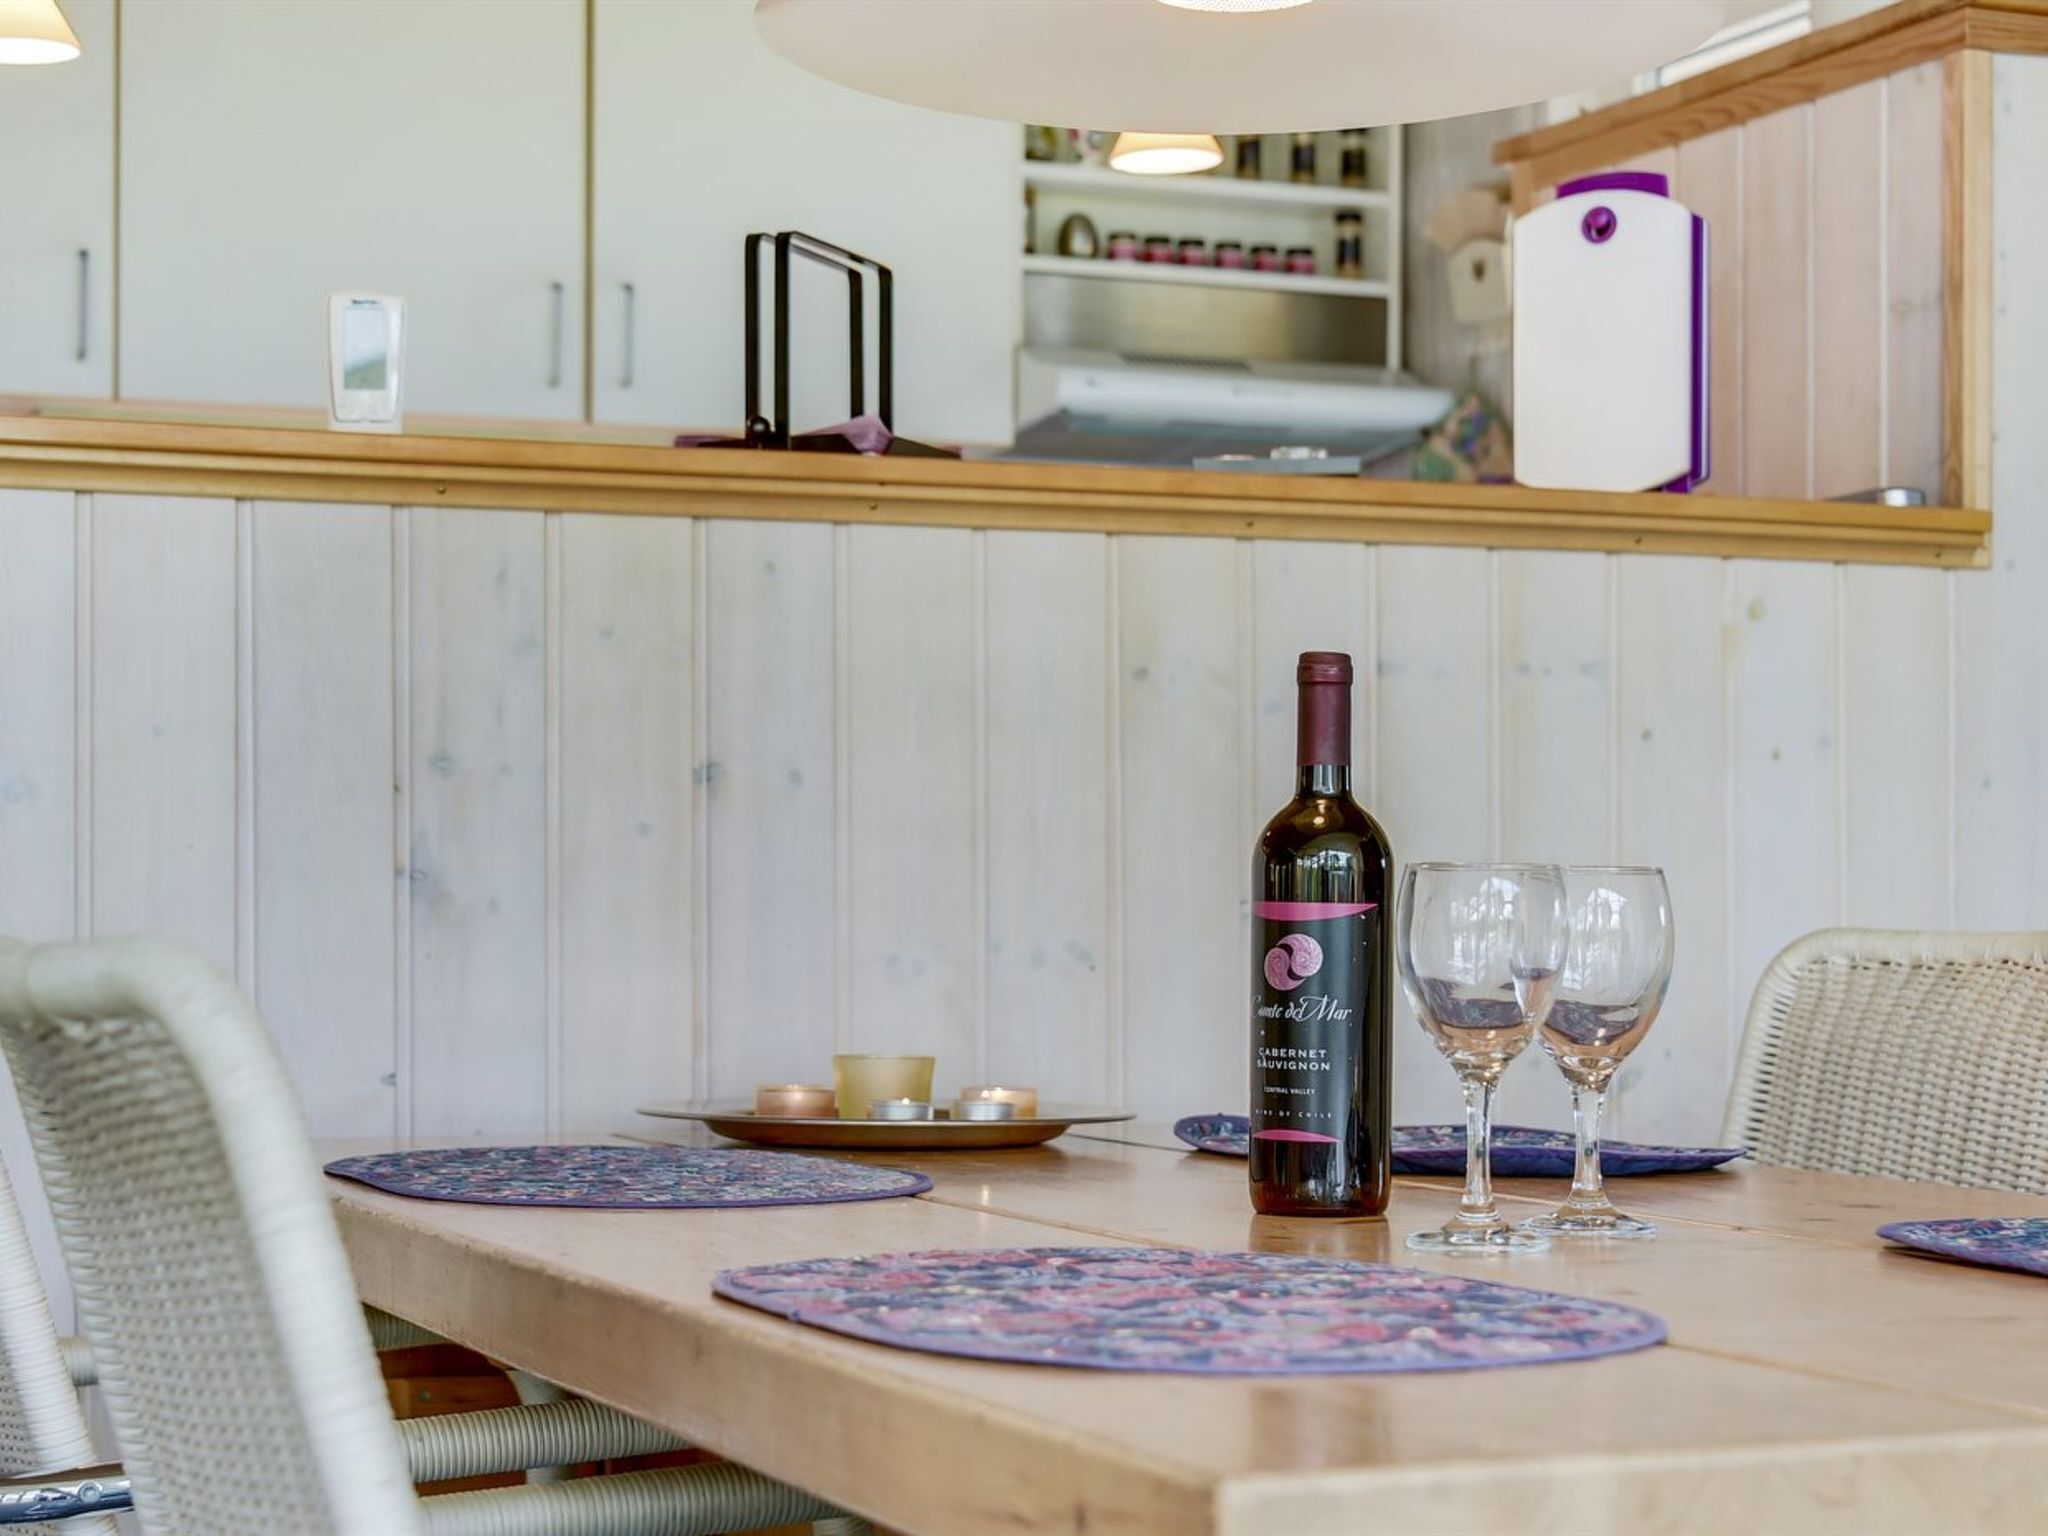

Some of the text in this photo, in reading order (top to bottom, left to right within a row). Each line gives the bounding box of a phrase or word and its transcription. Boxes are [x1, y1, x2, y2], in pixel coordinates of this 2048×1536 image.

[1300, 993, 1353, 1021] Mar
[1258, 1047, 1327, 1059] CABERNET
[1256, 1059, 1331, 1071] SAUVIGNON
